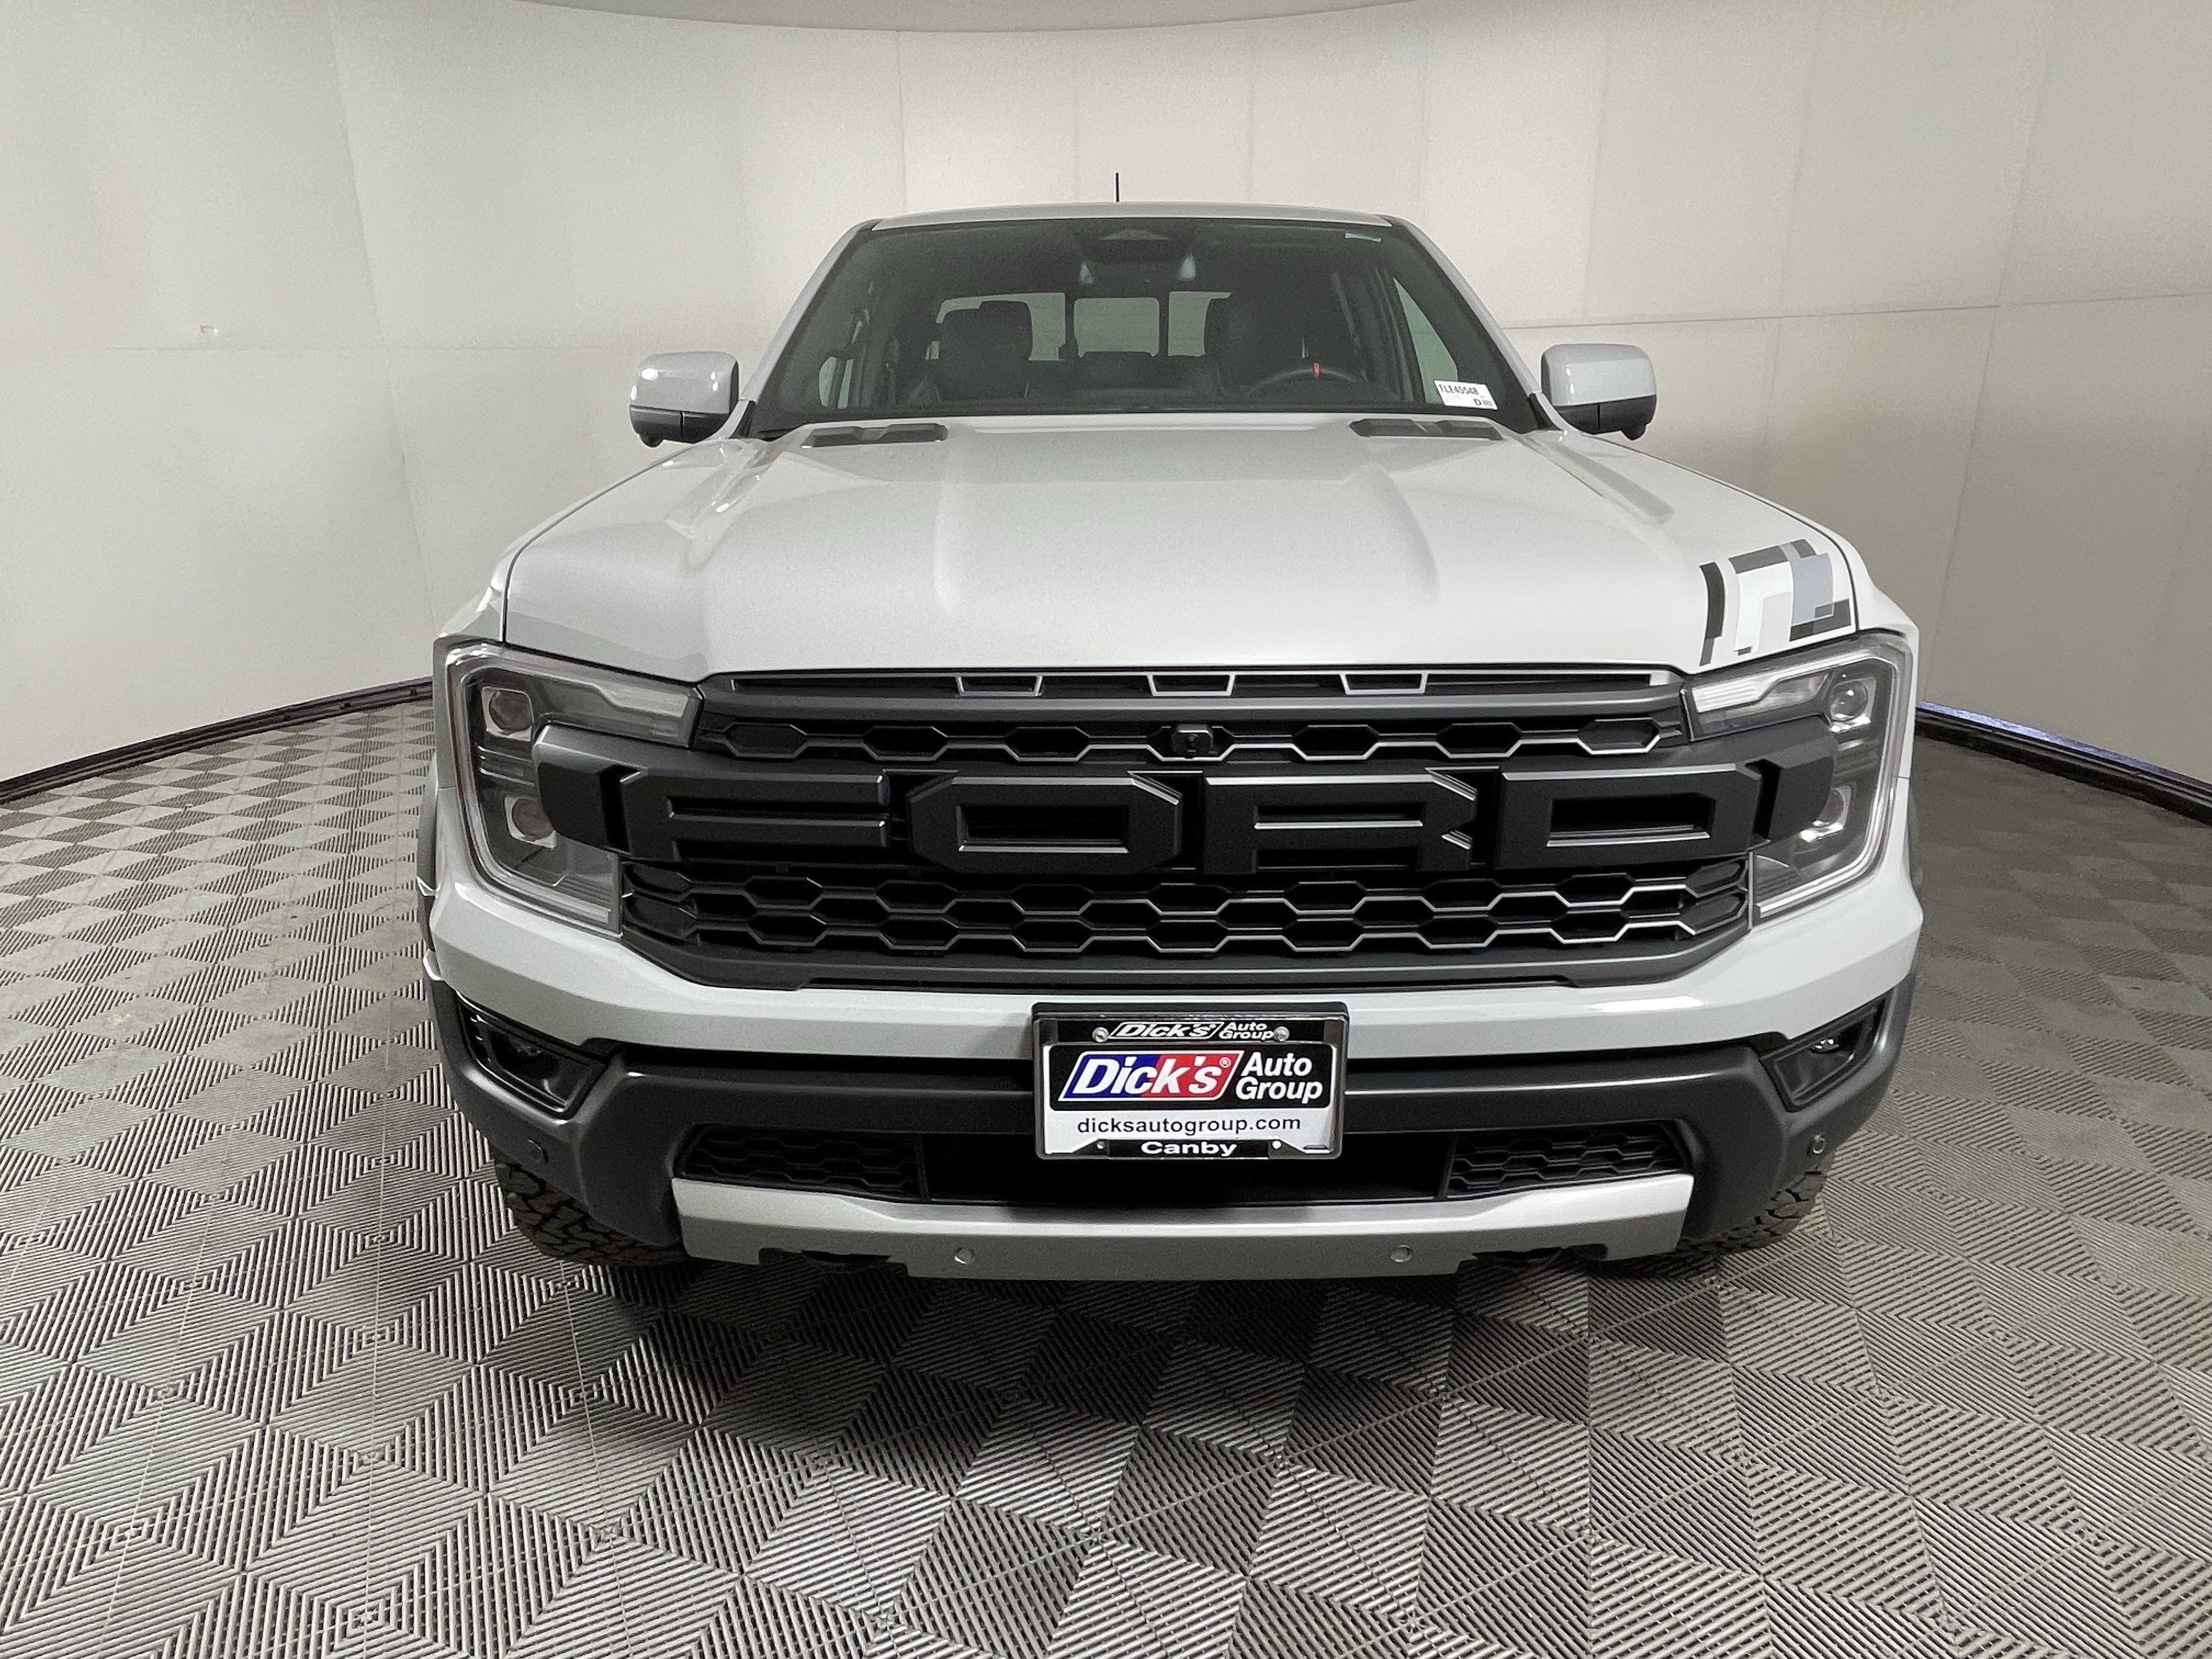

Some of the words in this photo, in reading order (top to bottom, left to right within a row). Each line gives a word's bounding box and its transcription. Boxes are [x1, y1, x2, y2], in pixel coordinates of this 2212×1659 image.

[620, 766, 1761, 874] FORD
[1116, 1023, 1210, 1037] Dick's
[1223, 1022, 1268, 1031] Auto
[1218, 1030, 1274, 1040] Group
[1071, 1056, 1223, 1094] Dick's
[1241, 1052, 1313, 1076] Auto
[1235, 1076, 1323, 1104] Group
[1077, 1117, 1301, 1136] dicksautogroup.com
[1141, 1141, 1238, 1157] Canby
